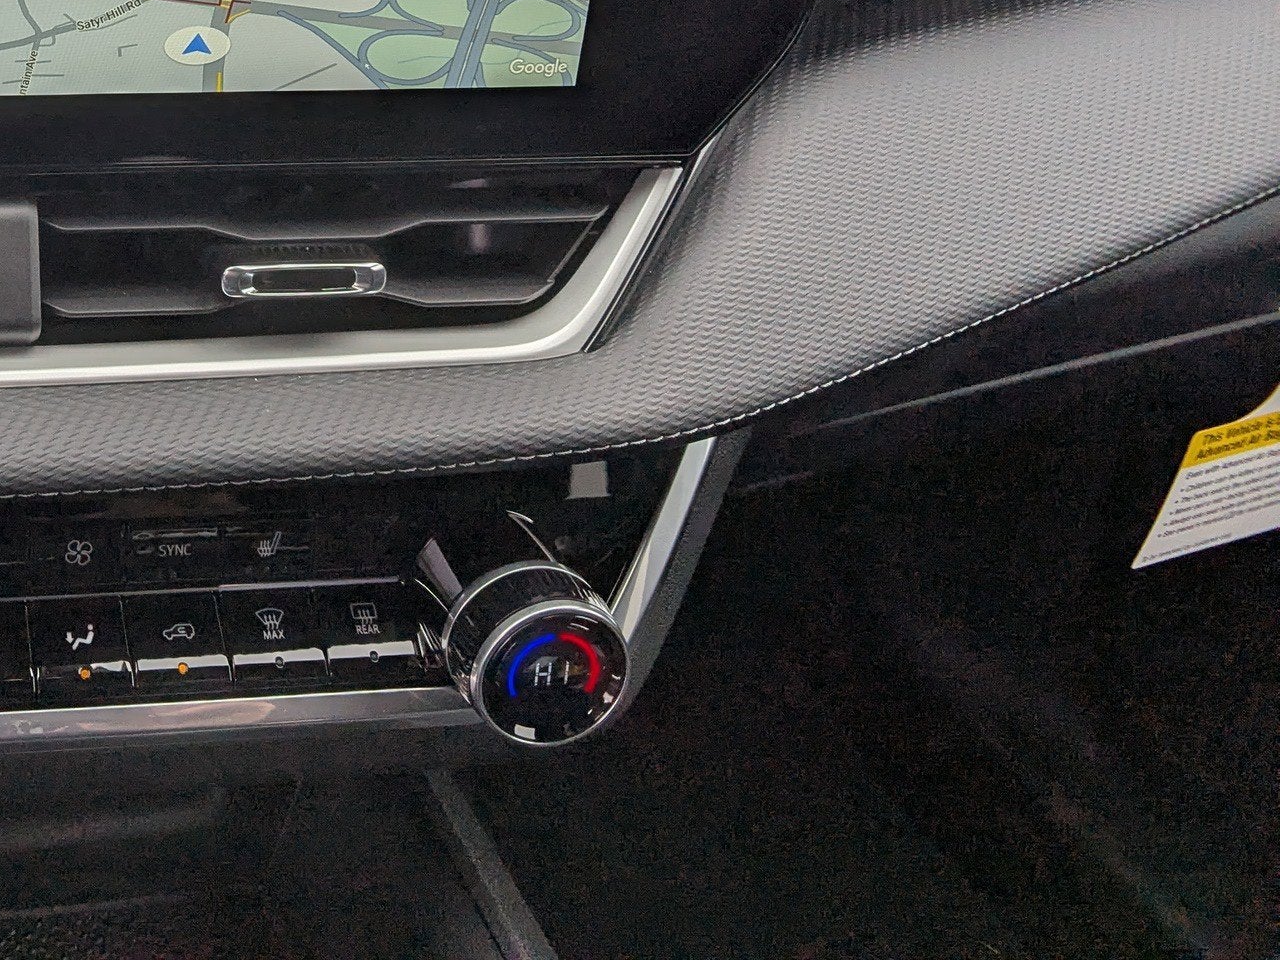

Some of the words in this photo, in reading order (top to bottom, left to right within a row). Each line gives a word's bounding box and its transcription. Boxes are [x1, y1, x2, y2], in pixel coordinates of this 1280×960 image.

[76, 16, 105, 31] Satyr
[106, 6, 125, 22] Hill
[509, 59, 568, 77] Google
[158, 544, 192, 557] SYNC
[263, 630, 285, 640] MAX
[355, 624, 381, 635] REAR
